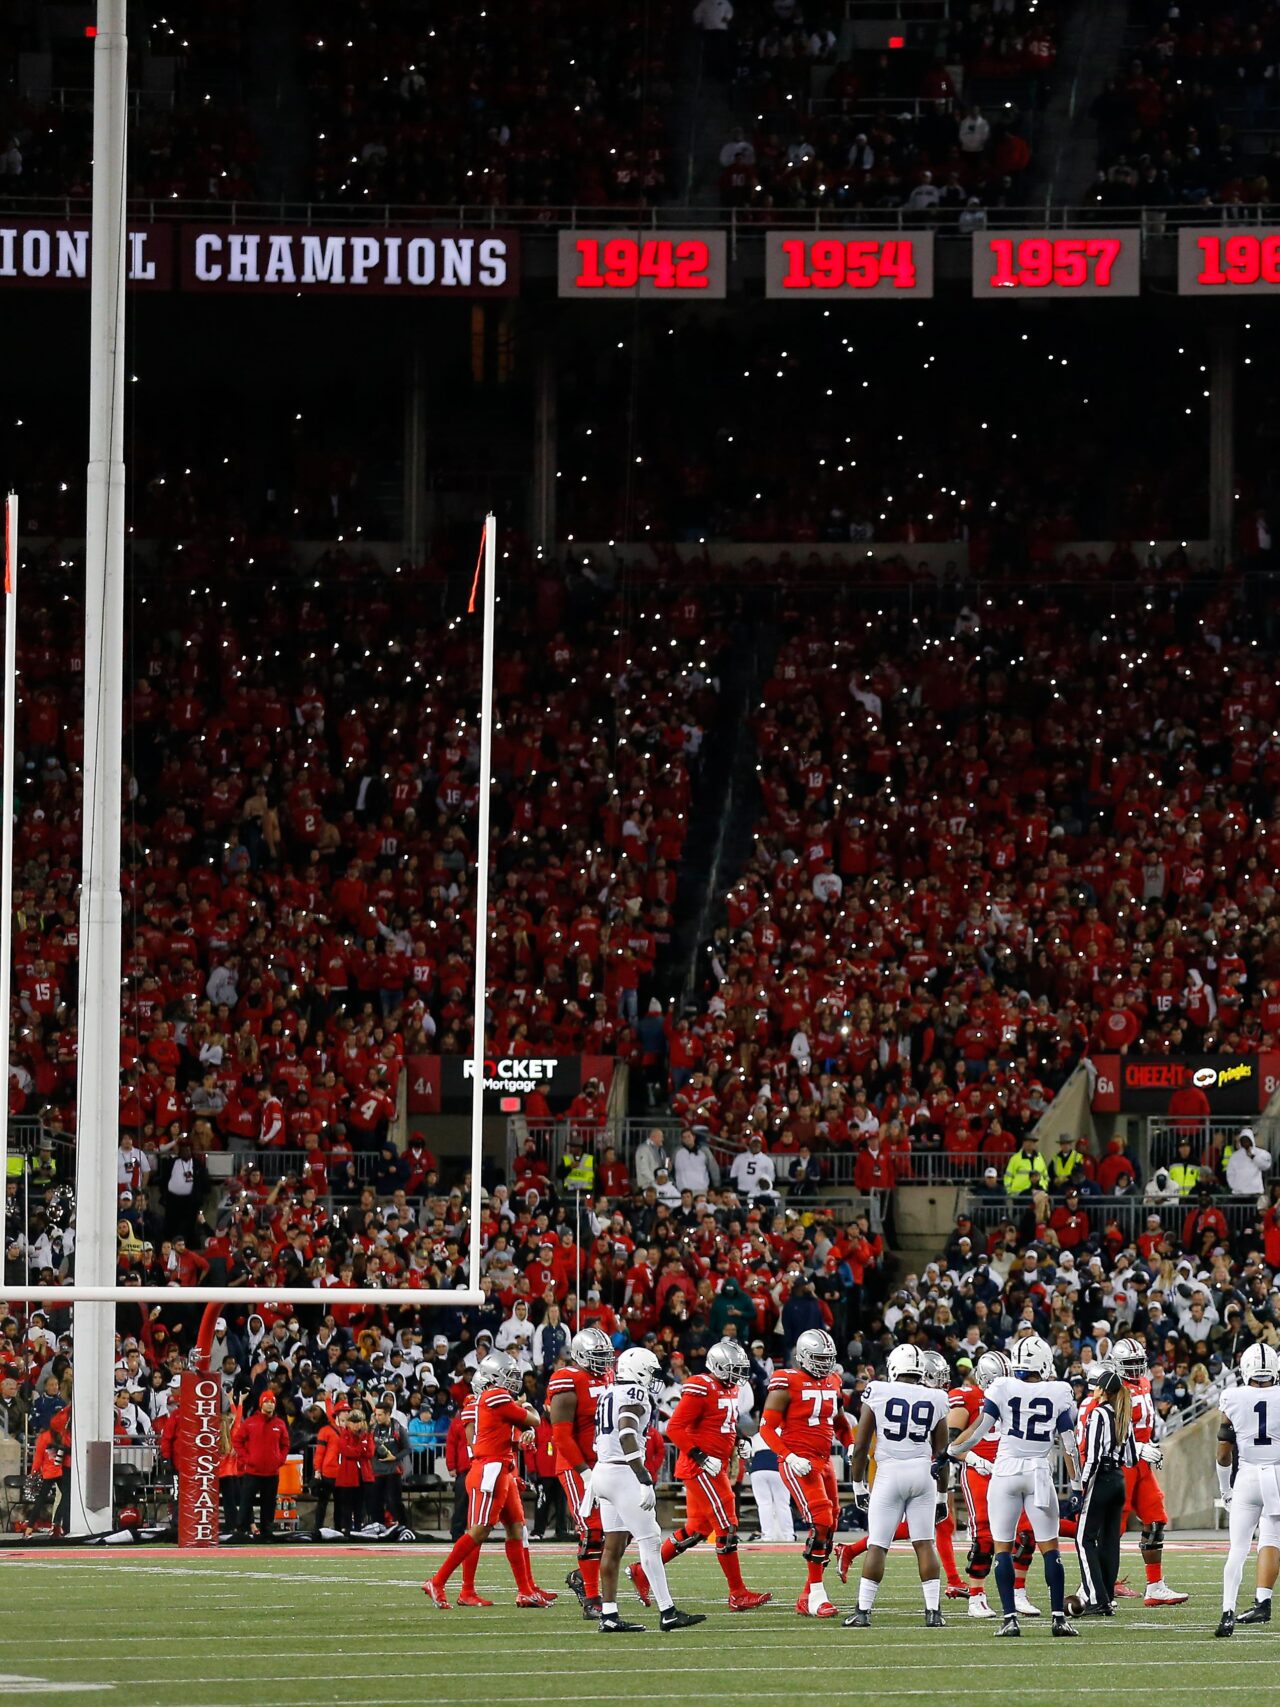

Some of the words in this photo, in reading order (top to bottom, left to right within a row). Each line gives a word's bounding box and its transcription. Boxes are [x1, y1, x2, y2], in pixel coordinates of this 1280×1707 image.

[0, 229, 156, 280] IONL
[195, 233, 507, 287] CHAMPIONS
[575, 238, 710, 288] 1942
[782, 239, 916, 288] 1954
[990, 238, 1121, 287] 1957
[396, 785, 408, 798] 17
[305, 815, 315, 831] 2
[382, 838, 397, 854] 10
[762, 929, 773, 944] 15
[414, 966, 429, 981] 97
[36, 984, 49, 1000] 15
[774, 1062, 787, 1079] 17
[1126, 1063, 1186, 1087] CHEEZ-IT
[1218, 1063, 1252, 1088] Pringles
[414, 1078, 432, 1094] 4A
[1097, 1077, 1114, 1093] 6A
[167, 1097, 177, 1111] 2
[361, 1100, 375, 1119] 4
[627, 1386, 645, 1402] 40
[194, 1380, 220, 1449] OHIO
[801, 1389, 840, 1427] 77
[883, 1397, 936, 1443] 99
[1007, 1396, 1051, 1442] 12
[1253, 1400, 1272, 1446] 1
[194, 1455, 216, 1541] STATE
